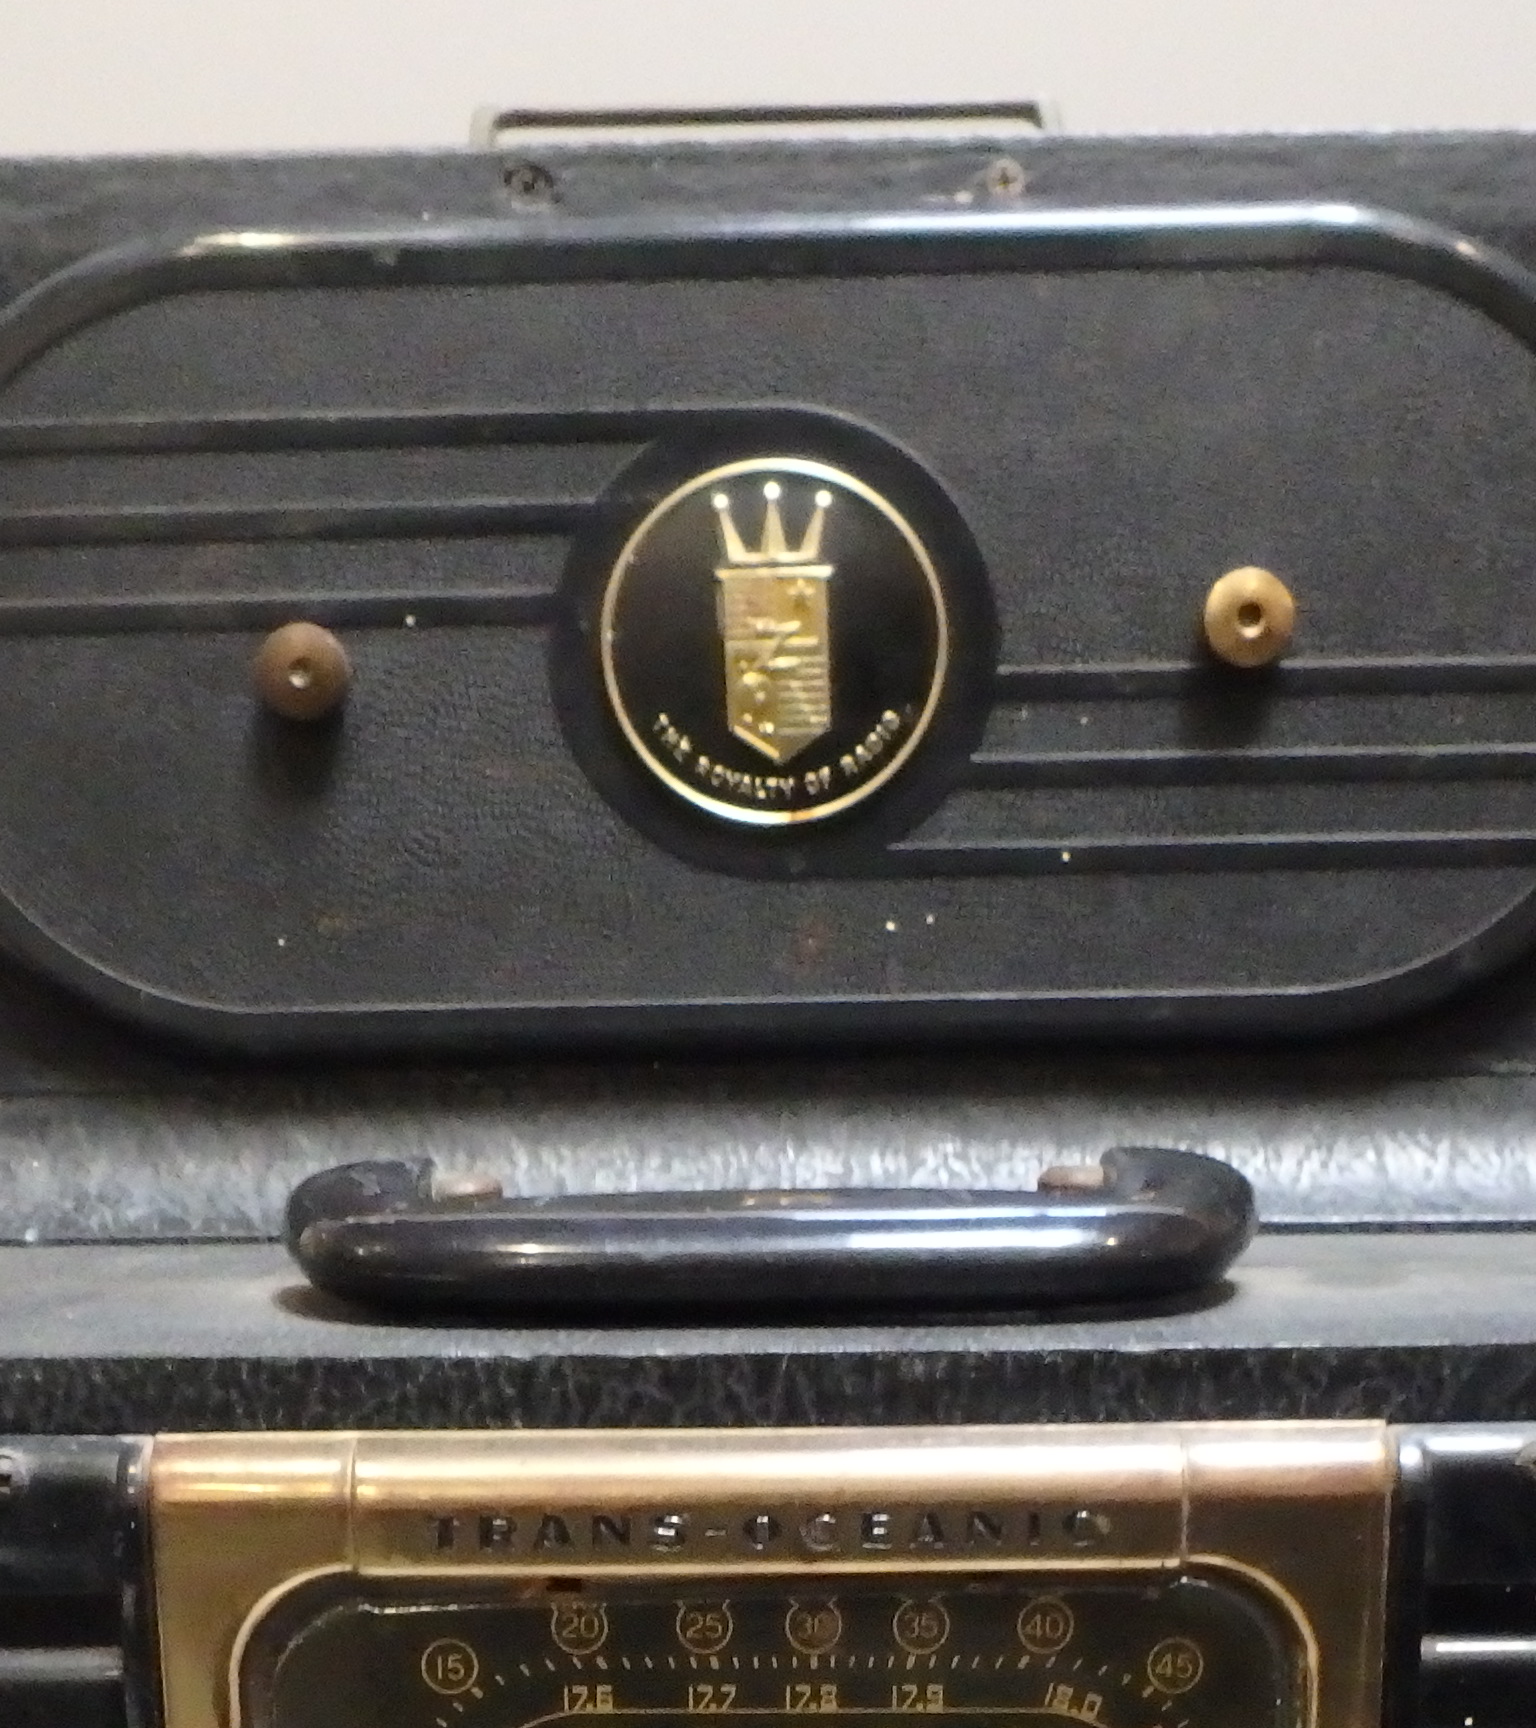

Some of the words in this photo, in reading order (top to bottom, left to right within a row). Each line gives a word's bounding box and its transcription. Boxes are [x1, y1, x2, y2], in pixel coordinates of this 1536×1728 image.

[563, 1613, 600, 1639] 20
[684, 1613, 723, 1639] 25
[800, 1613, 834, 1639] 30
[902, 1613, 940, 1639] 35
[1024, 1613, 1065, 1639] 40
[436, 1652, 465, 1681] 15
[1154, 1653, 1195, 1680] 45
[562, 1684, 613, 1712] 17.6
[687, 1684, 738, 1712] 17.7
[785, 1684, 838, 1712] 17.8
[891, 1684, 944, 1712] 17.9
[1044, 1682, 1104, 1721] 18.0
